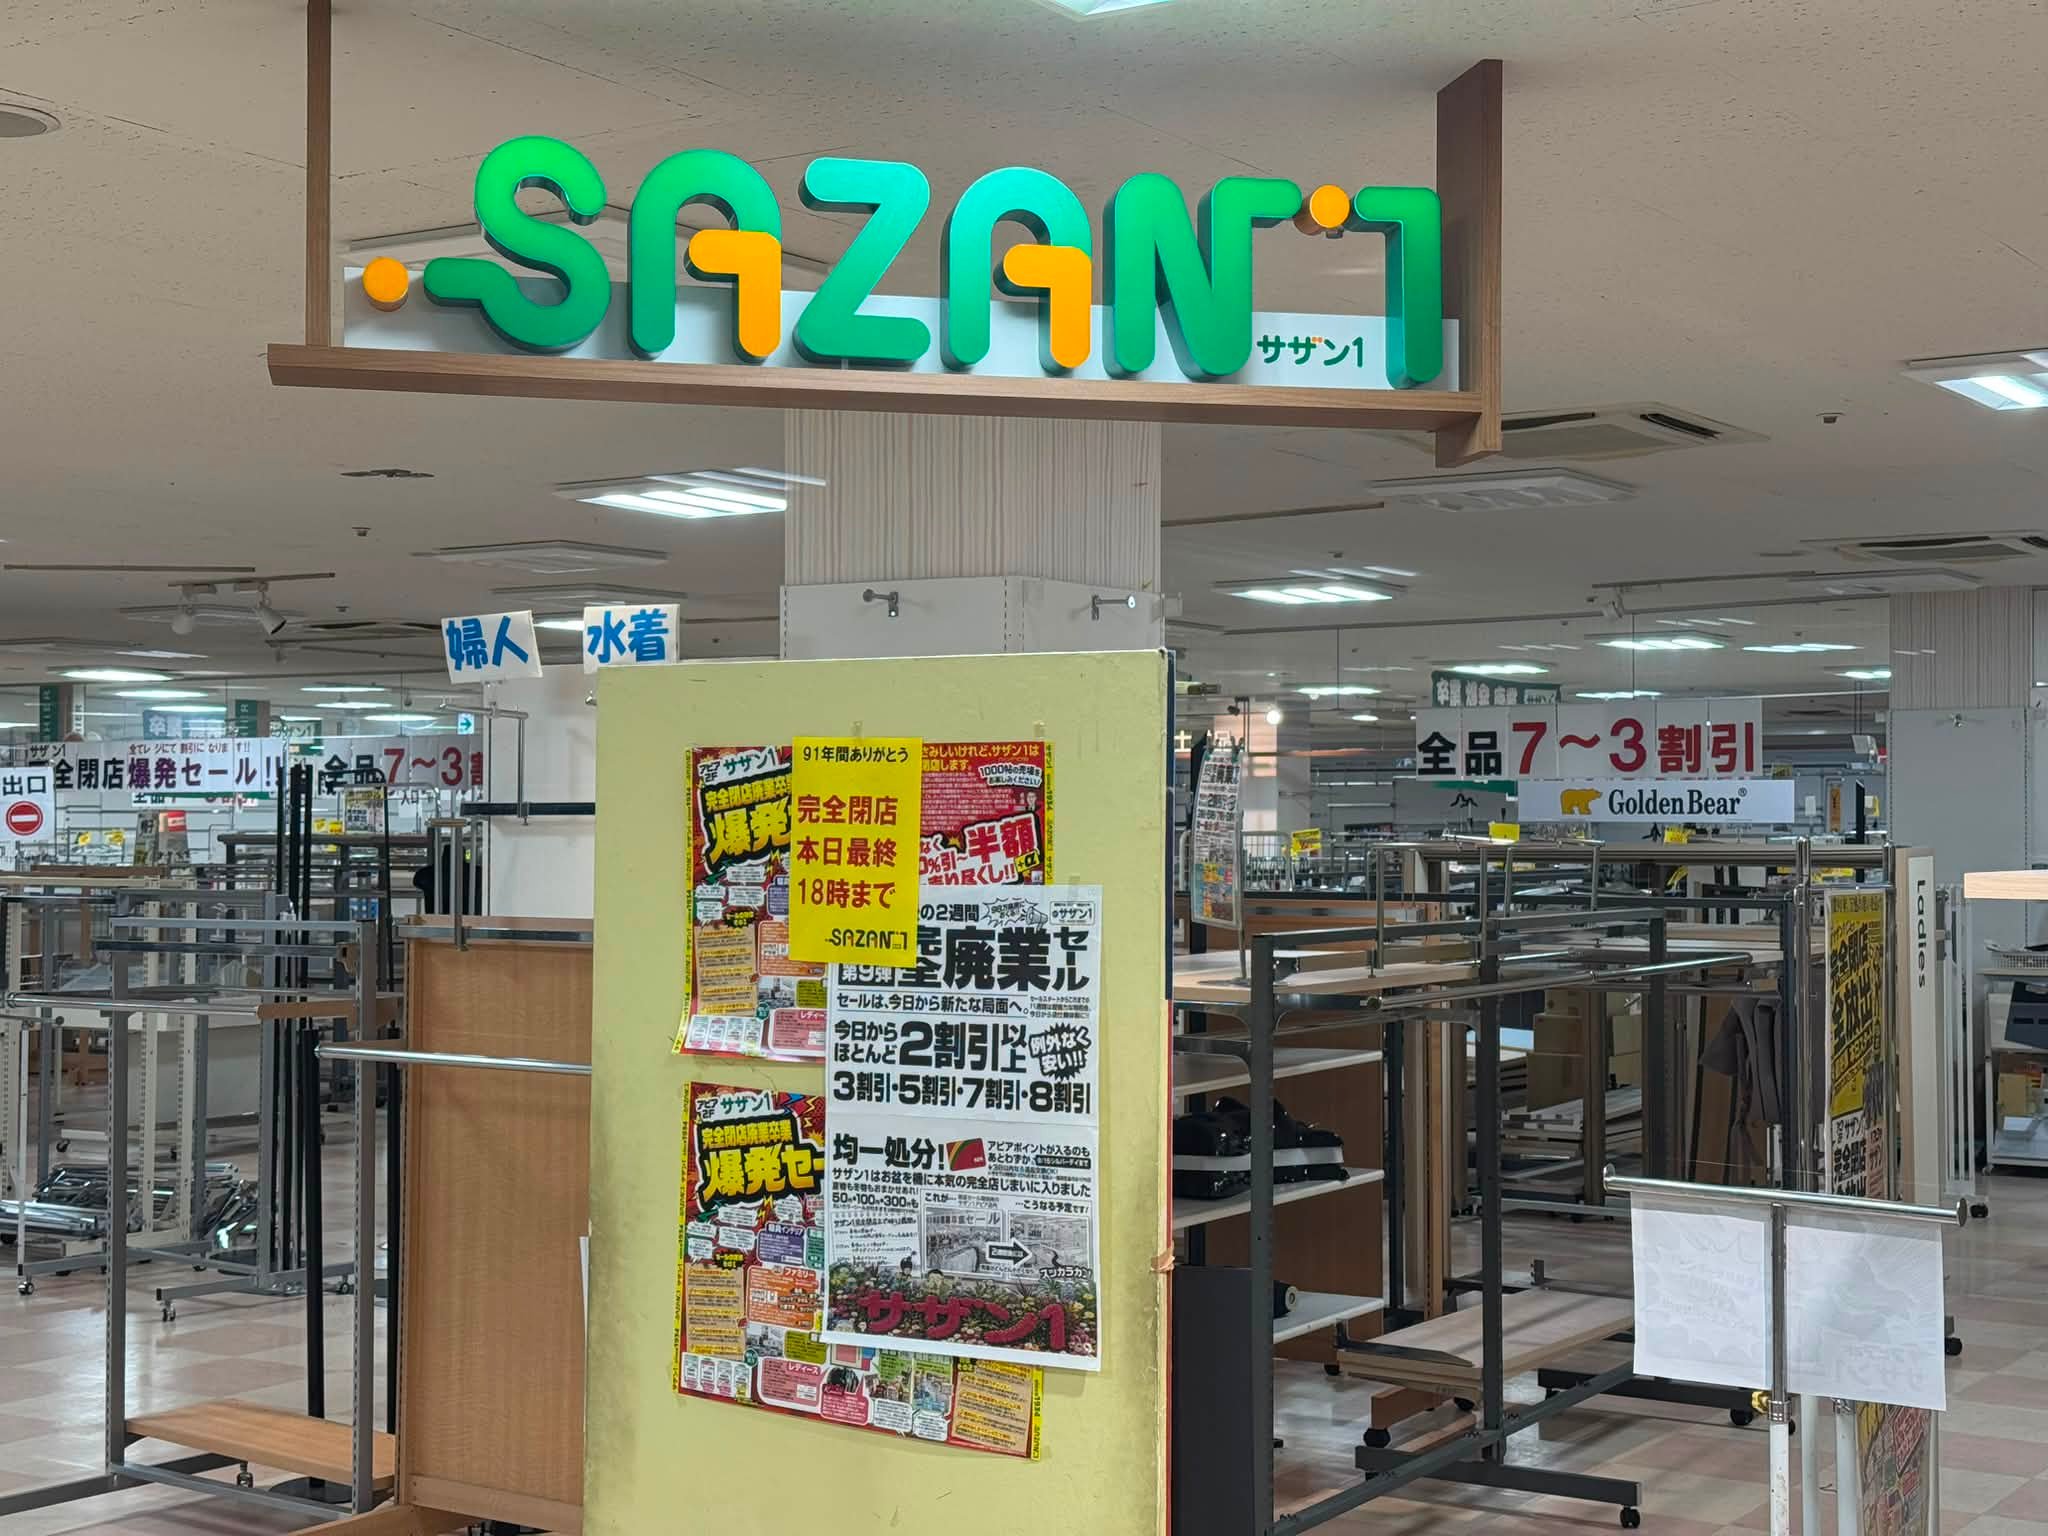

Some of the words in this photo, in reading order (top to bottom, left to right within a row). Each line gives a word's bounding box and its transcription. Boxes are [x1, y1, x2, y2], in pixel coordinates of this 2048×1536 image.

[1256, 333, 1364, 368] サザン1
[446, 615, 529, 671] 婦人
[587, 608, 669, 664] 水着
[30, 744, 66, 757] サザン1
[723, 748, 777, 776] サザン1
[802, 745, 909, 764] 91年間ありがとう
[3, 775, 47, 796] 出口
[28, 757, 282, 791] 全閉店爆発セール!!
[797, 794, 899, 826] 完全閉店
[1608, 788, 1686, 815] Golden
[1688, 788, 1741, 815] Bear
[709, 796, 792, 865] 爆発
[967, 816, 1035, 864] 半額
[796, 836, 897, 868] 本日最終
[797, 877, 896, 909] 18時まで
[1916, 879, 1927, 989] Ladies
[943, 925, 1051, 992] 廃業
[837, 992, 1029, 1016] セールは、今日から新たな局面へ。
[834, 1019, 898, 1042] 今日から
[1029, 1025, 1092, 1056] 例外なく
[834, 1042, 896, 1065] ほとんど
[720, 1092, 771, 1114] サザン1
[833, 1132, 946, 1171] 均一処分!
[855, 1289, 1067, 1350] サザン1
[787, 1361, 820, 1376] レディース
